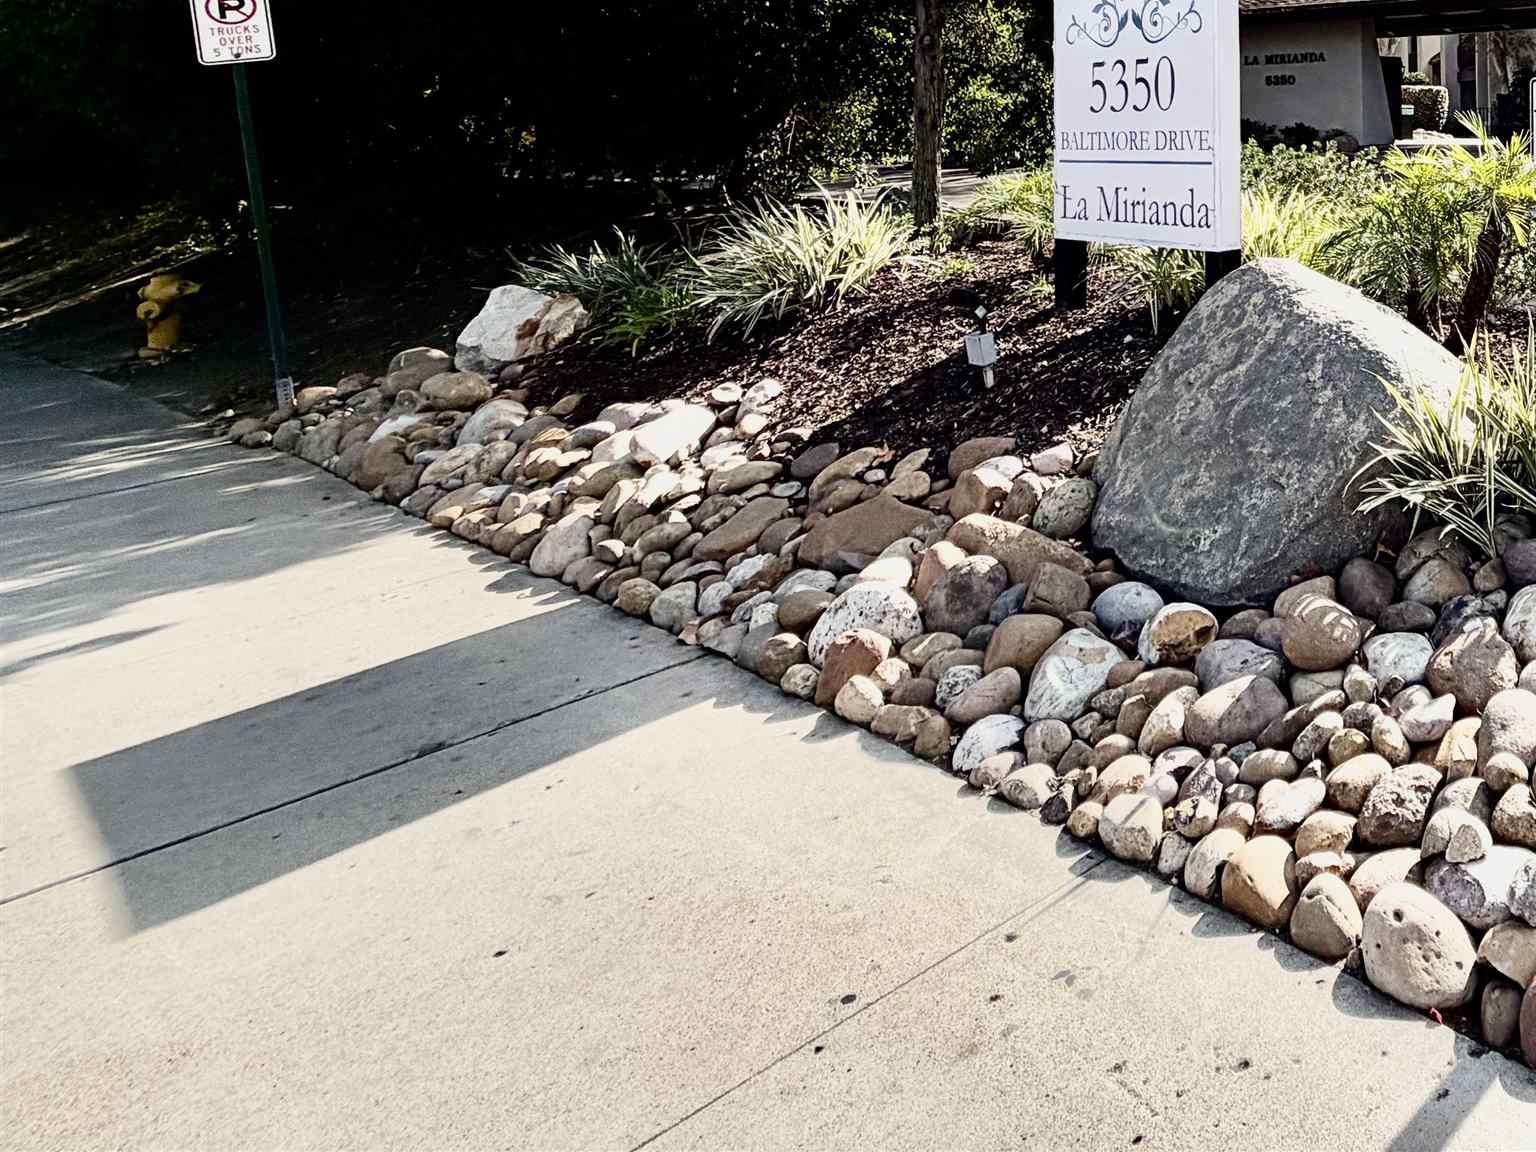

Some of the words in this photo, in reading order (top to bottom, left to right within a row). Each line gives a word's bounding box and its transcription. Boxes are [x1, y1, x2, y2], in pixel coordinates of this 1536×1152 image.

[209, 24, 260, 36] TRUCKS
[219, 35, 253, 46] OVER
[213, 48, 221, 57] 5
[227, 44, 262, 57] TONS
[1243, 55, 1260, 66] LA
[1264, 52, 1326, 65] MIRIANDA
[1090, 55, 1176, 113] 5350
[1265, 75, 1296, 86] 5350
[1060, 130, 1150, 151] BALTIMORE
[1153, 130, 1210, 151] DRIVE
[1060, 185, 1089, 221] La
[1096, 185, 1212, 229] Mirianda
